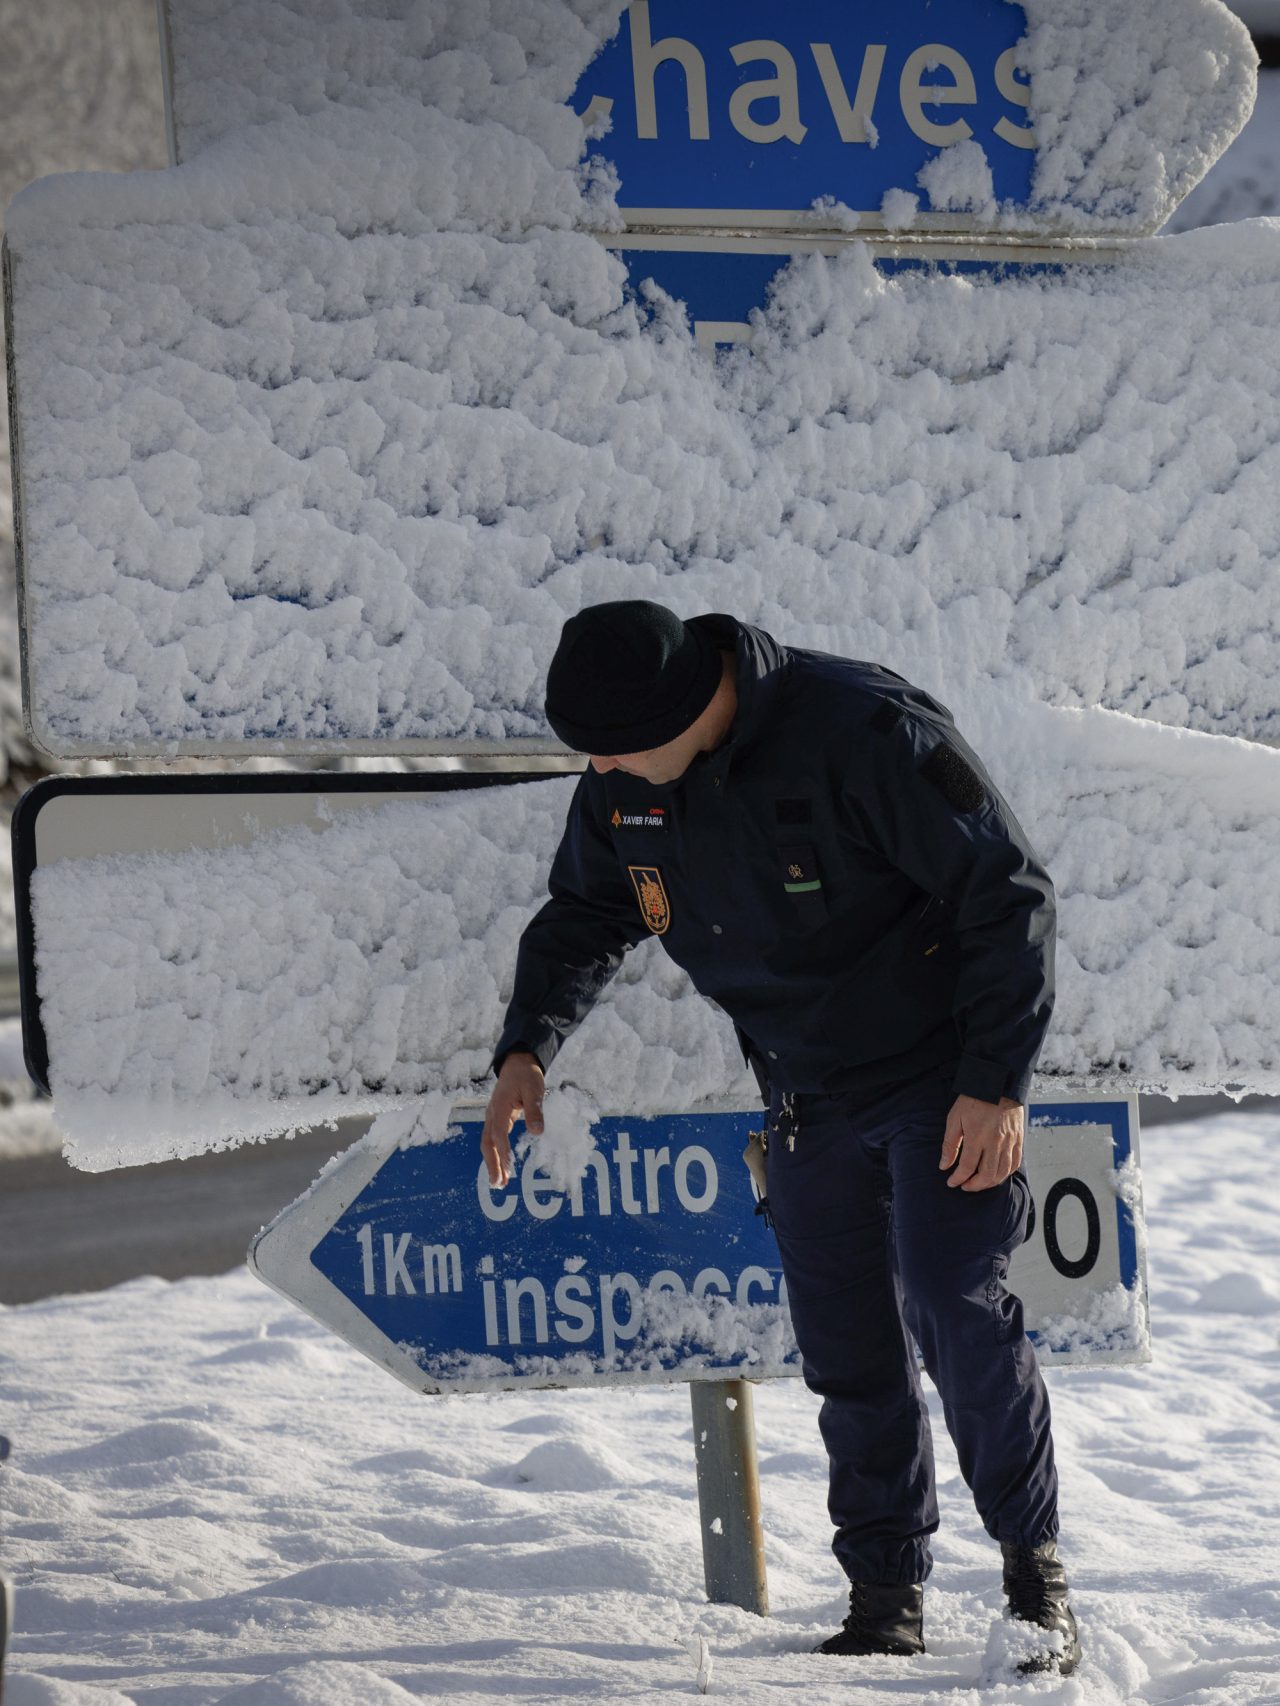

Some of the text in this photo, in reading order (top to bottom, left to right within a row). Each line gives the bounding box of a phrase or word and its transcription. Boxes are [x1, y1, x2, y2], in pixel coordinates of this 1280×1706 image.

[581, 0, 1036, 148] haves
[644, 816, 663, 826] FARIA
[477, 1132, 718, 1222] centro
[356, 1223, 463, 1296] 1Km
